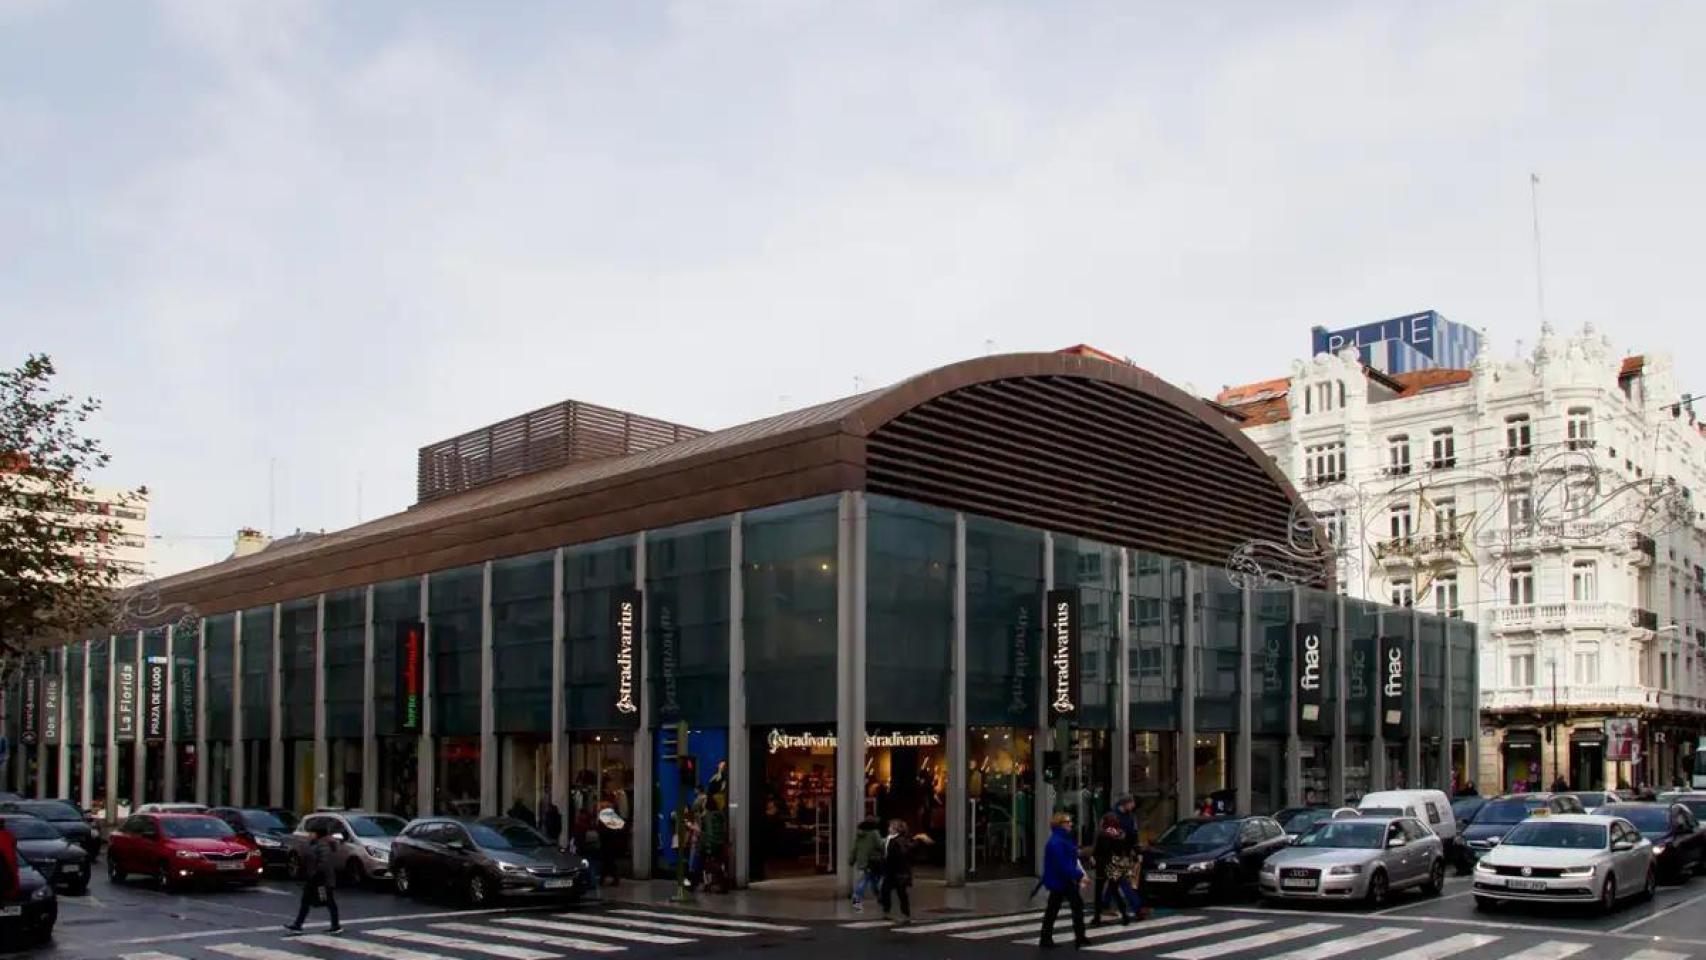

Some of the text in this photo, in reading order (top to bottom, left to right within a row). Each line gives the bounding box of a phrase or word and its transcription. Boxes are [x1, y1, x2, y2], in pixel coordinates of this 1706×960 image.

[616, 602, 633, 703] stradivarius
[1052, 601, 1069, 702] stradivarius
[1300, 634, 1320, 691] fnac
[1384, 647, 1402, 697] fnac
[120, 664, 133, 732] La Florida
[151, 666, 162, 735] PRAZA DE LUGO
[865, 729, 939, 747] stradivarius
